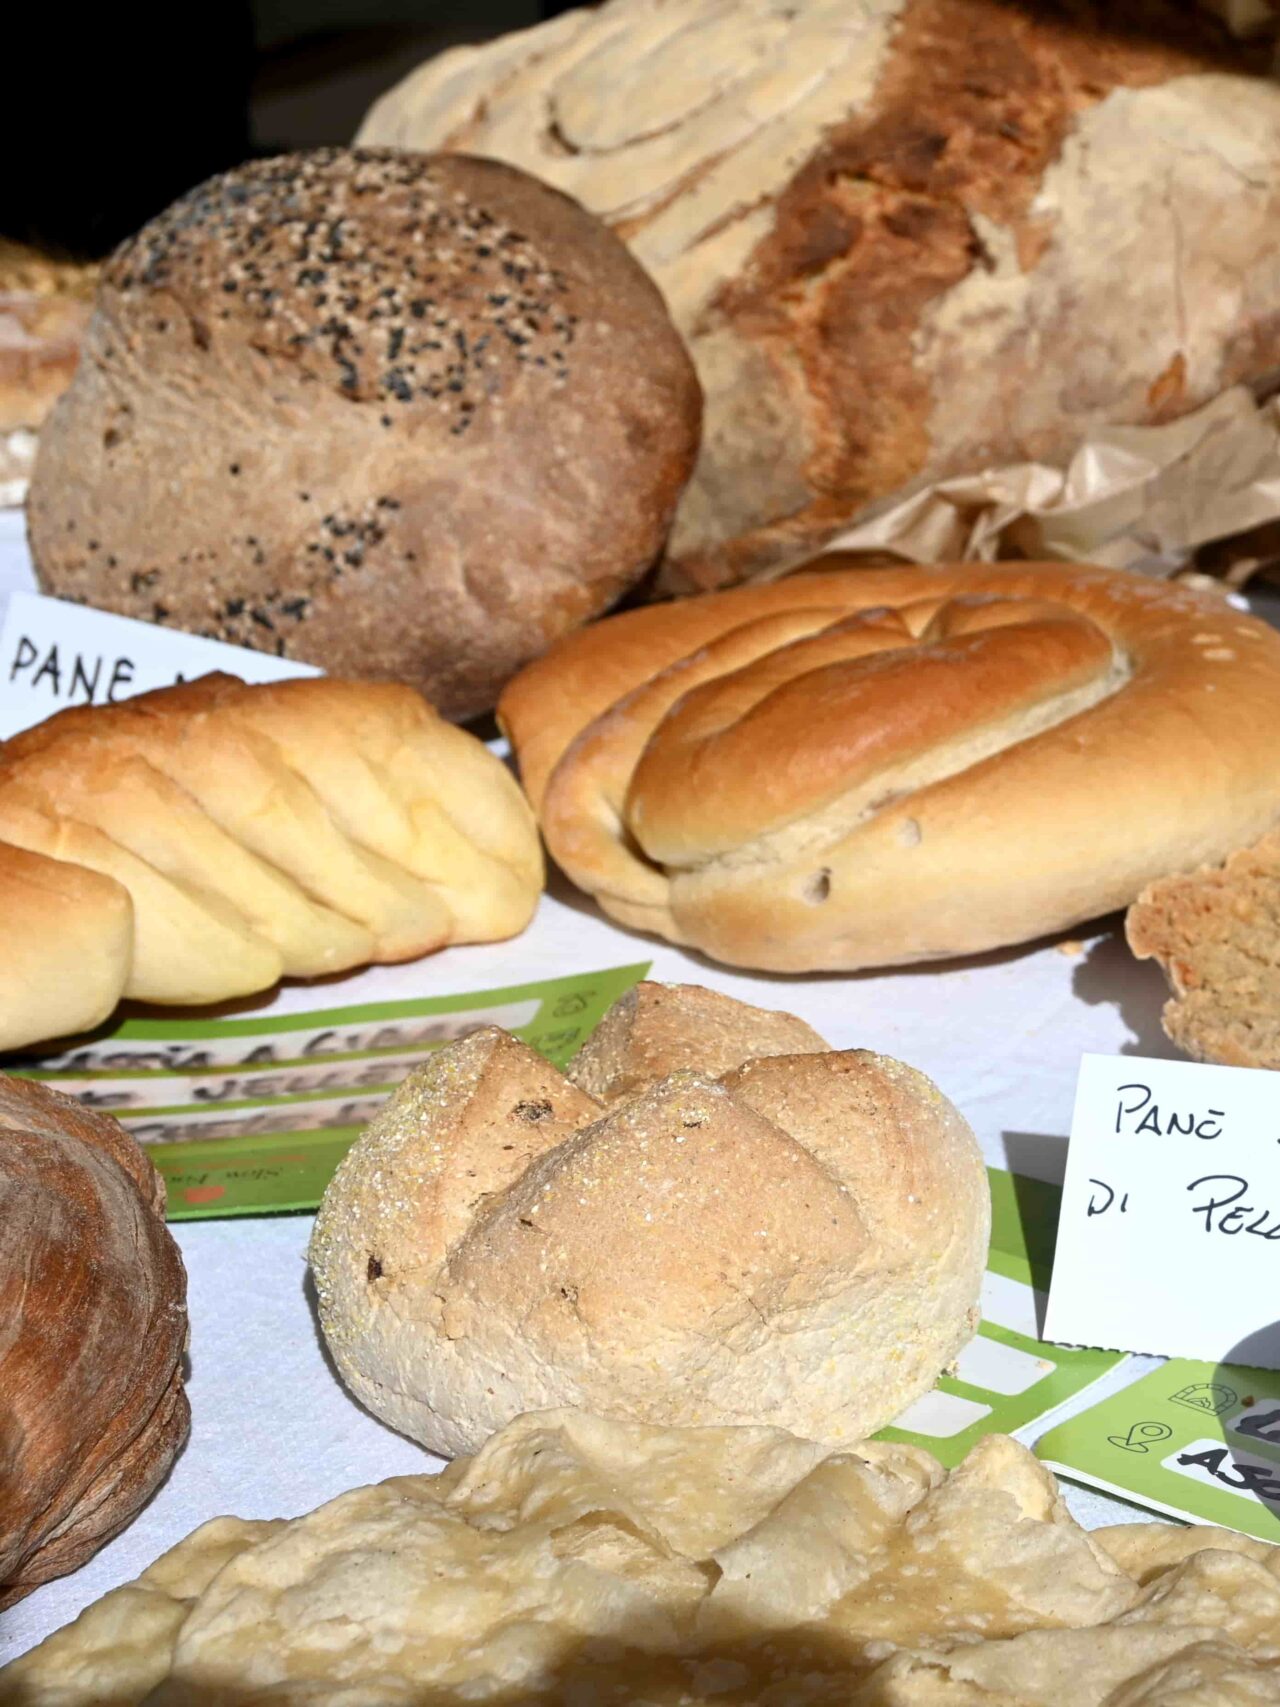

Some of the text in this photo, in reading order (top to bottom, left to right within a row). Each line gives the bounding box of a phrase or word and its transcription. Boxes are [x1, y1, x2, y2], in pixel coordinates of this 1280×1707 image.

[10, 634, 135, 706] PANE
[1115, 1083, 1226, 1141] PANE
[1086, 1178, 1130, 1218] DI
